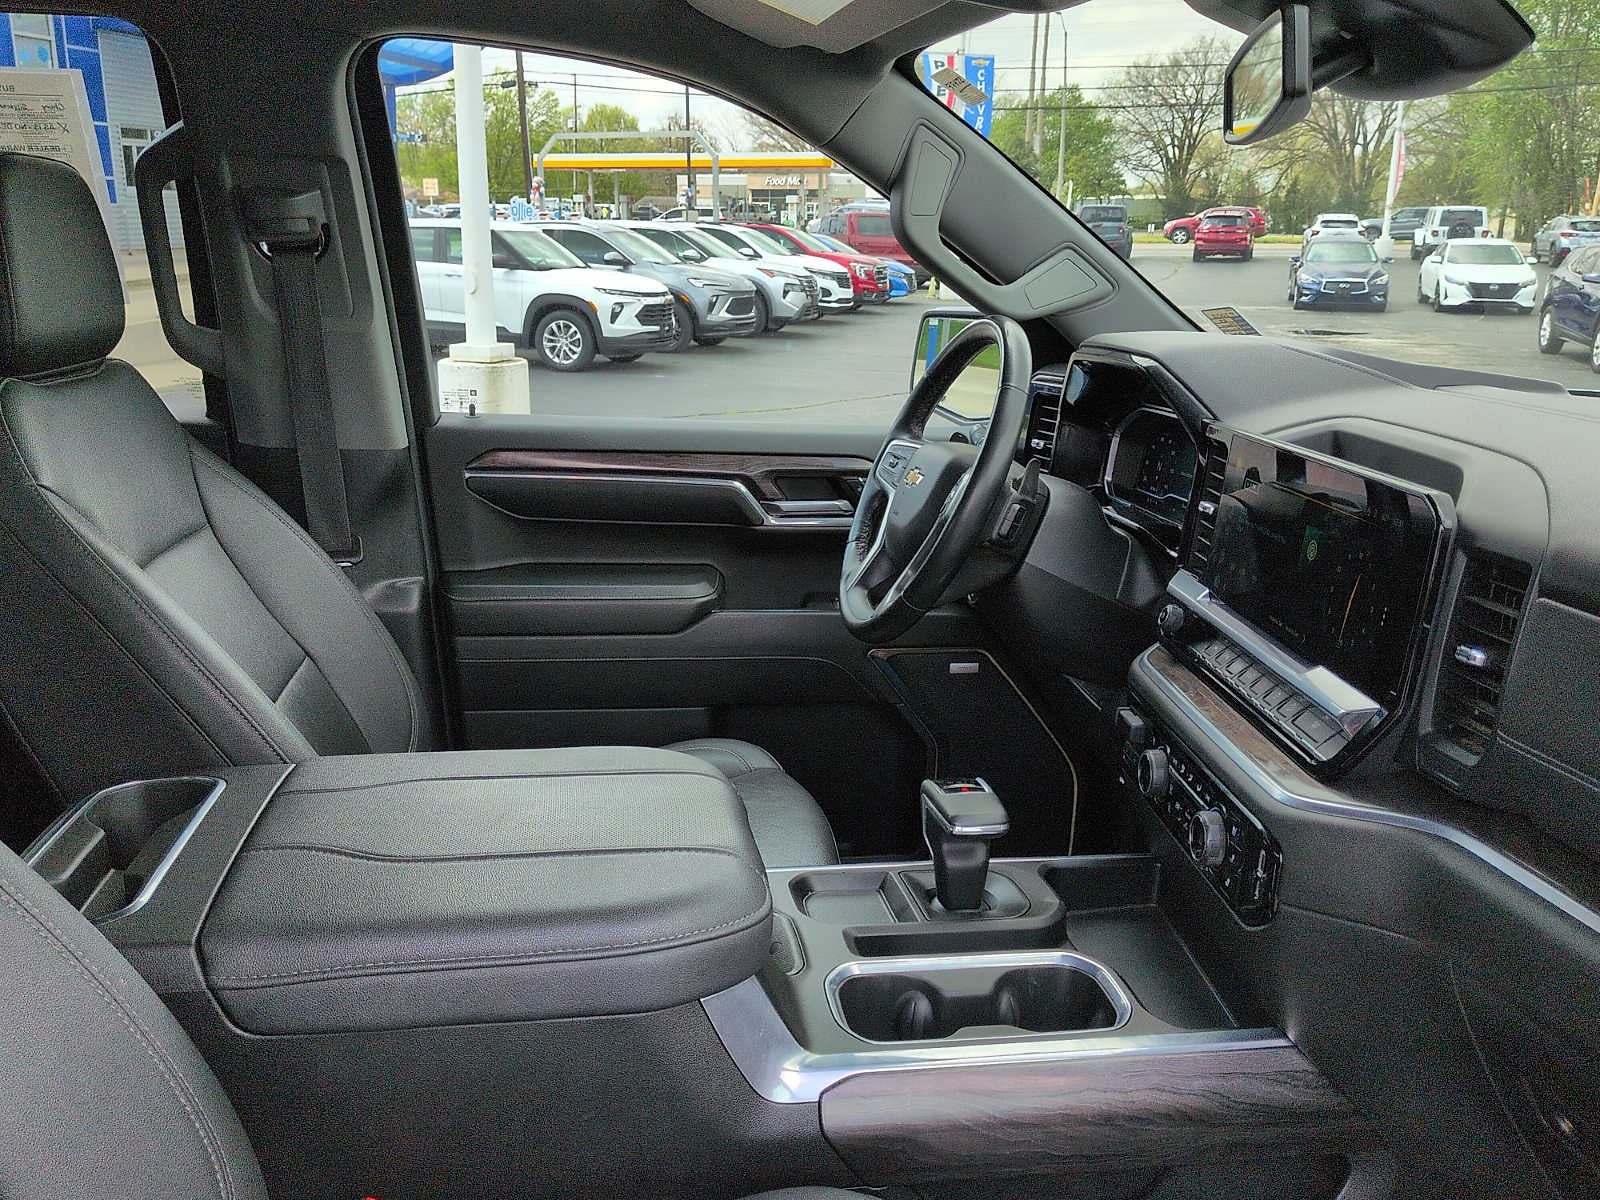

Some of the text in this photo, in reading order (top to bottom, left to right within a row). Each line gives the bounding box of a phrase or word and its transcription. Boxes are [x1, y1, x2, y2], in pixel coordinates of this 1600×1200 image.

[934, 60, 946, 96] PE
[975, 69, 986, 132] CHVR
[765, 176, 808, 186] Food Mat
